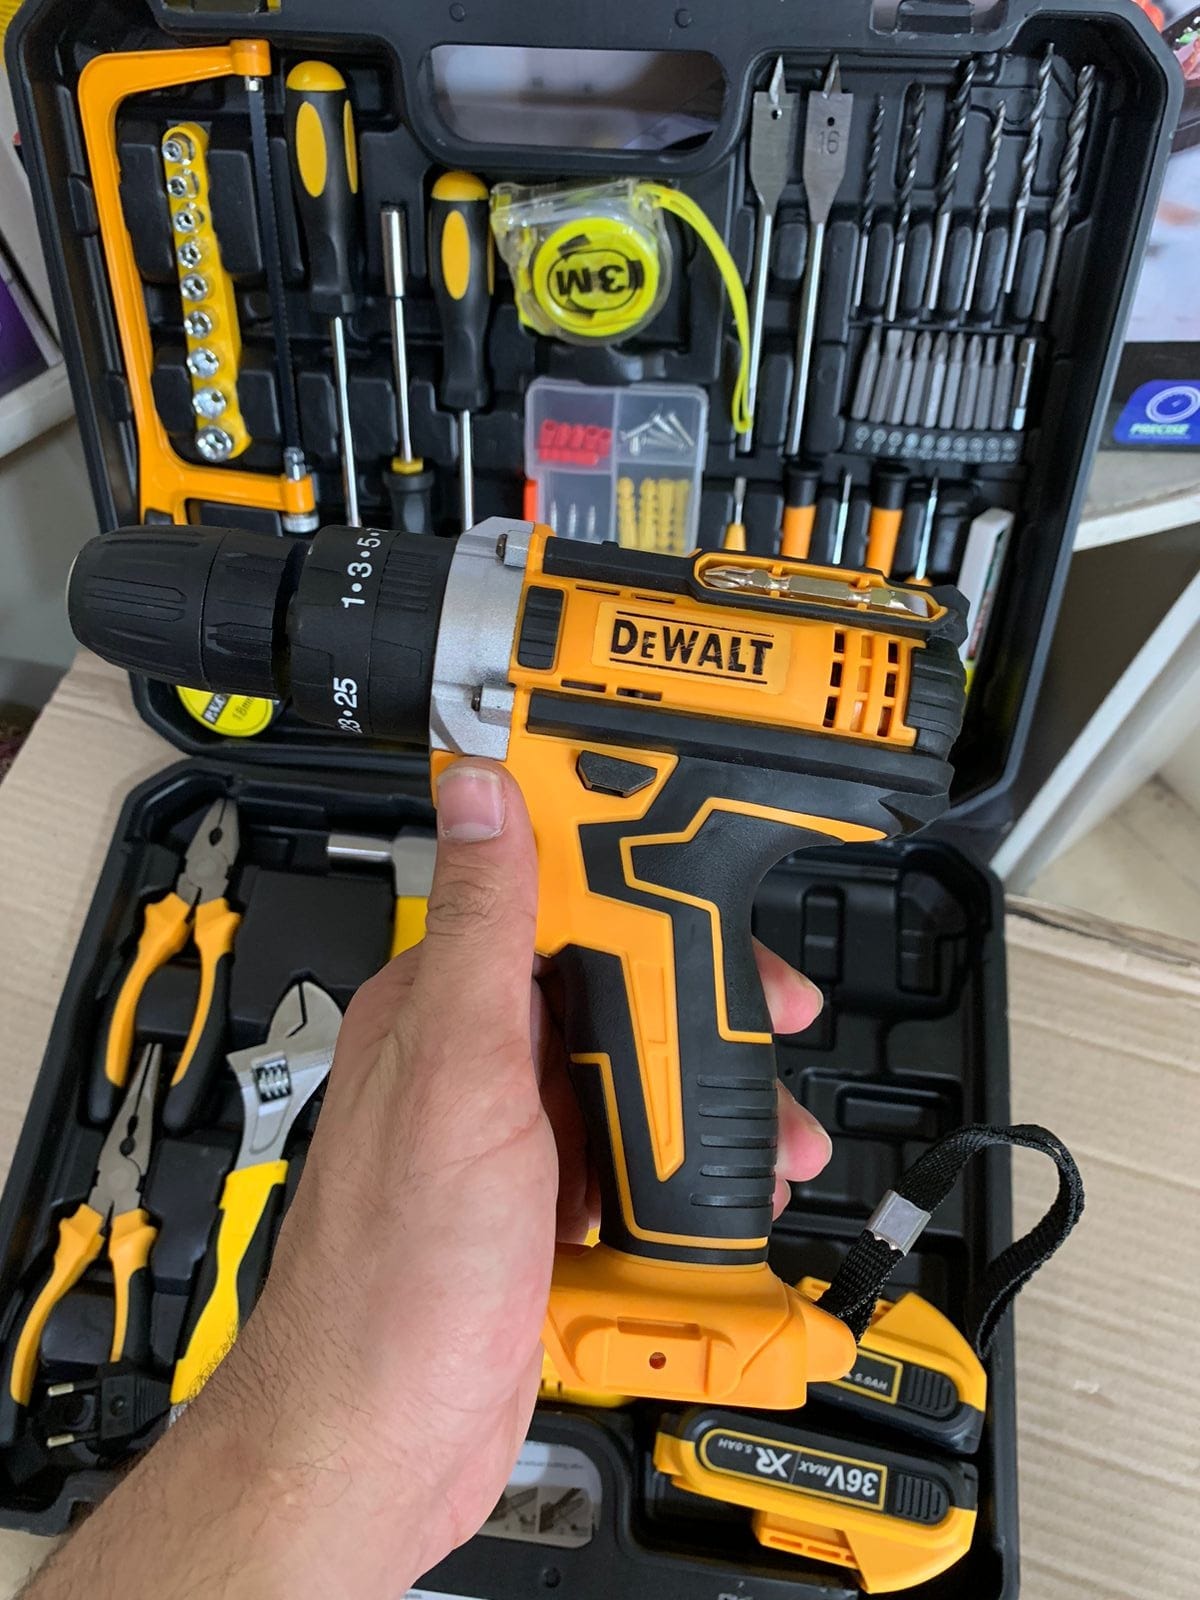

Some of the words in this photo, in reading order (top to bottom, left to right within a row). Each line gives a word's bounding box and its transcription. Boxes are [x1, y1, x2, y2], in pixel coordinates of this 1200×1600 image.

[817, 130, 840, 155] 16
[556, 264, 625, 296] 3M
[333, 677, 358, 708] 25
[717, 1437, 754, 1455] 5.0AH
[754, 1446, 793, 1479] XR
